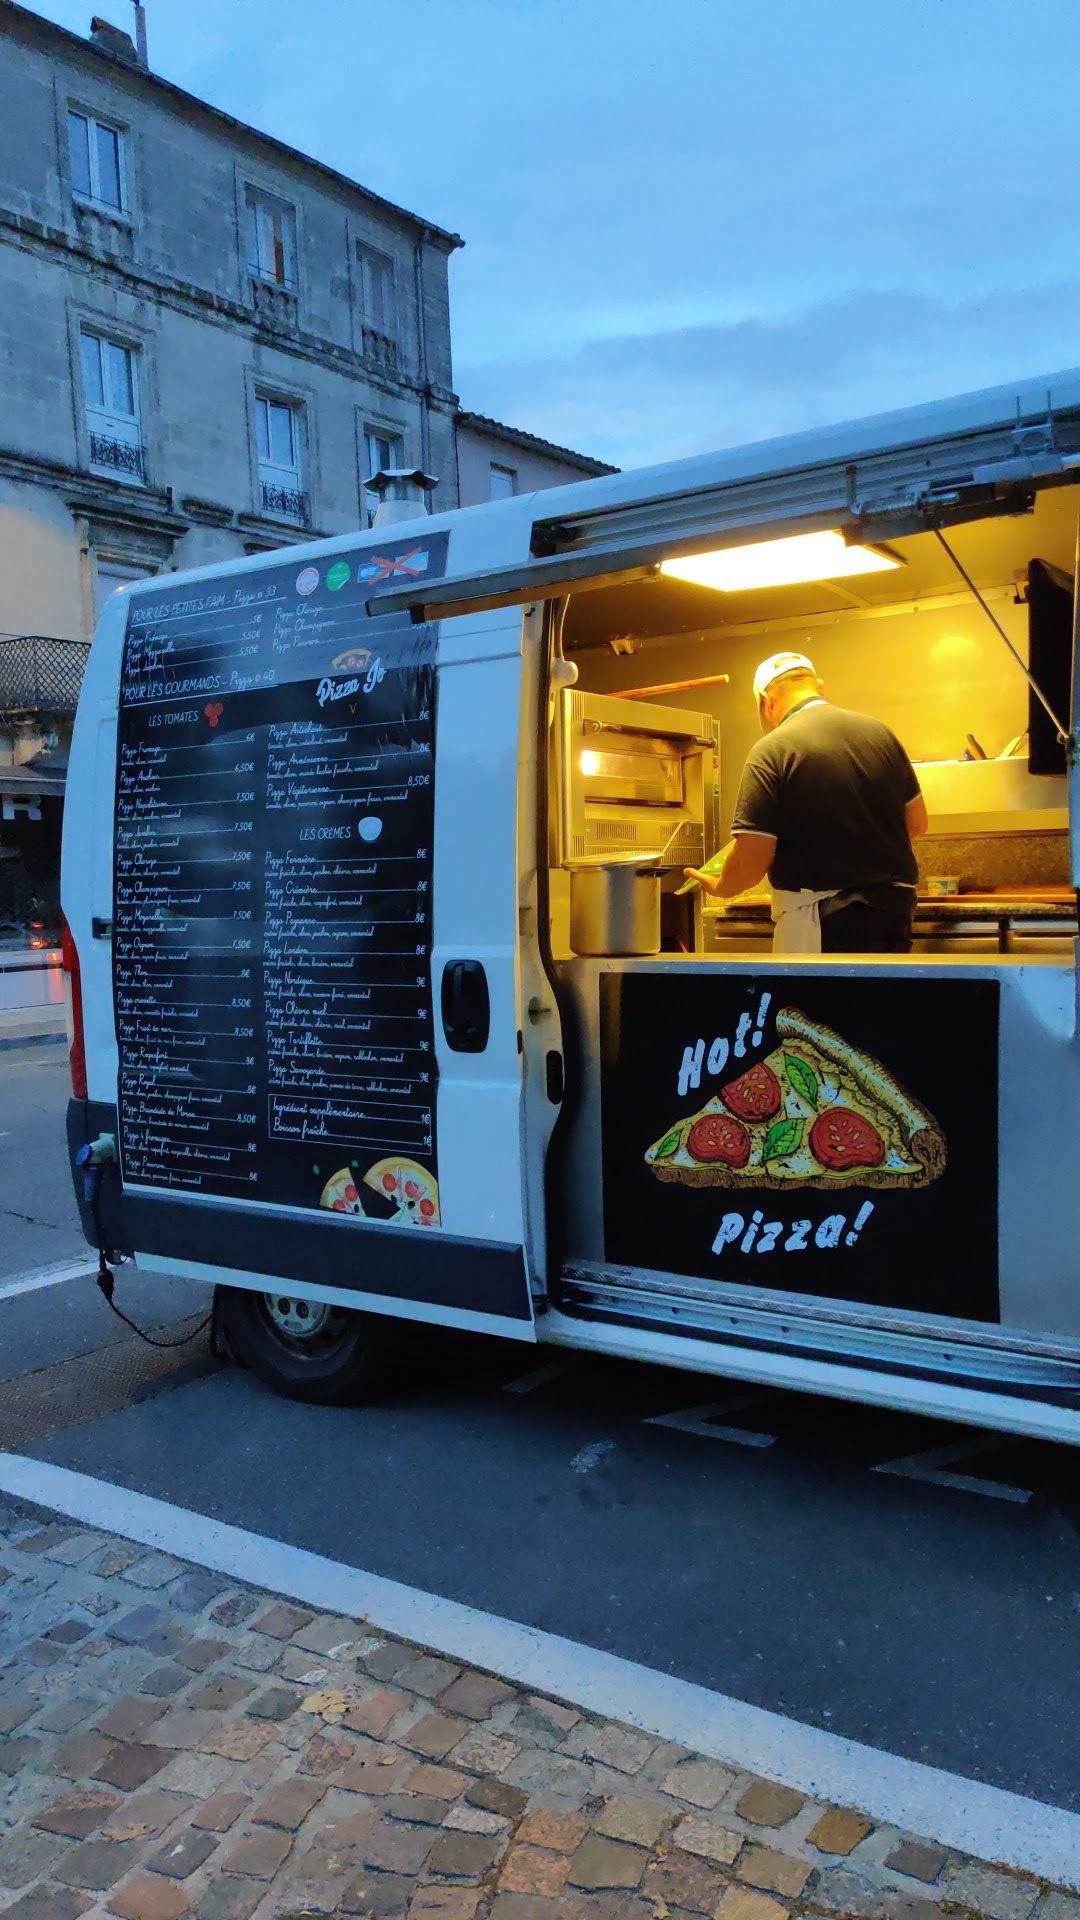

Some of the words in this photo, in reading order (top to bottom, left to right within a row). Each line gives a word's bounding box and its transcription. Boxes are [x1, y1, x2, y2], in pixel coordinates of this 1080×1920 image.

[132, 608, 153, 622] POUR
[153, 605, 169, 618] LES
[170, 598, 204, 615] PETITES
[205, 594, 226, 608] FAIM
[234, 590, 255, 606] Pizza
[266, 585, 277, 597] 33
[275, 608, 294, 620] Pizza
[253, 615, 262, 623] 5€
[274, 623, 292, 638] Pizza
[273, 639, 291, 654] Pizza
[124, 687, 146, 701] POUR
[147, 682, 163, 697] LES
[165, 676, 221, 695] GOURMANDS
[230, 671, 254, 689] Pizza
[264, 669, 275, 681] 40
[316, 677, 359, 707] Pizza
[363, 656, 387, 693] Jo
[149, 715, 162, 727] LES
[164, 711, 199, 725] TOMATES
[269, 725, 288, 741] Pizza
[419, 710, 430, 720] 8€
[121, 743, 137, 759] Pizza
[247, 732, 256, 742] 6€
[268, 755, 287, 770] Pizza
[420, 743, 430, 753] 8€
[120, 771, 135, 786] Pizza
[235, 762, 255, 773] 6,50€
[267, 784, 286, 801] Pizza
[407, 775, 430, 787] 8,50€
[118, 799, 134, 814] Pizza
[236, 791, 255, 803] 7,50€
[118, 826, 133, 842] Pizza
[234, 821, 254, 832] 7,50€
[300, 828, 315, 841] LES
[318, 826, 352, 839] CRÈMES
[117, 854, 133, 870] Pizza
[232, 851, 252, 861] 7,50€
[266, 851, 284, 870] Pizza
[417, 848, 427, 859] 8€
[117, 882, 133, 897] Pizza
[232, 881, 252, 891] 7,50€
[266, 881, 283, 900] Pizza
[417, 881, 427, 891] 8€
[117, 909, 133, 925] Pizza
[232, 910, 252, 920] 7,50€
[265, 911, 283, 929] Pizza
[414, 913, 425, 923] 8€
[116, 937, 132, 952] Pizza
[232, 940, 252, 949] 7,50€
[263, 941, 282, 959] Pizza
[415, 944, 426, 955] 8€
[116, 963, 132, 980] Pizza
[241, 969, 251, 978] 8€
[264, 970, 283, 988] Pizza
[416, 976, 426, 987] 9€
[118, 991, 133, 1007] Pizza
[231, 998, 252, 1008] 8,50€
[266, 1000, 284, 1018] Pizza
[417, 1008, 427, 1019] 9€
[119, 1019, 135, 1034] Pizza
[234, 1027, 254, 1037] 8,50€
[267, 1030, 286, 1048] Pizza
[419, 1040, 429, 1052] 9€
[677, 992, 772, 1096] Hot!
[123, 1046, 139, 1061] Pizza
[246, 1056, 255, 1066] 8€
[268, 1059, 287, 1077] Pizza
[420, 1072, 429, 1083] 9€
[121, 1072, 137, 1088] Pizza
[247, 1085, 256, 1094] 8€
[122, 1099, 137, 1115] Pizza
[237, 1113, 256, 1124] 8,50€
[273, 1097, 307, 1117] Ingrédient
[309, 1101, 365, 1120] supplémentaire
[421, 1113, 431, 1125] 1€
[123, 1126, 139, 1143] Pizza
[247, 1142, 257, 1152] 8€
[273, 1117, 300, 1133] Boisson
[302, 1120, 328, 1139] fraîche
[423, 1135, 432, 1147] 1€
[125, 1154, 141, 1169] Pizza
[248, 1172, 258, 1181] 8€
[711, 1200, 875, 1255] Pizza!
